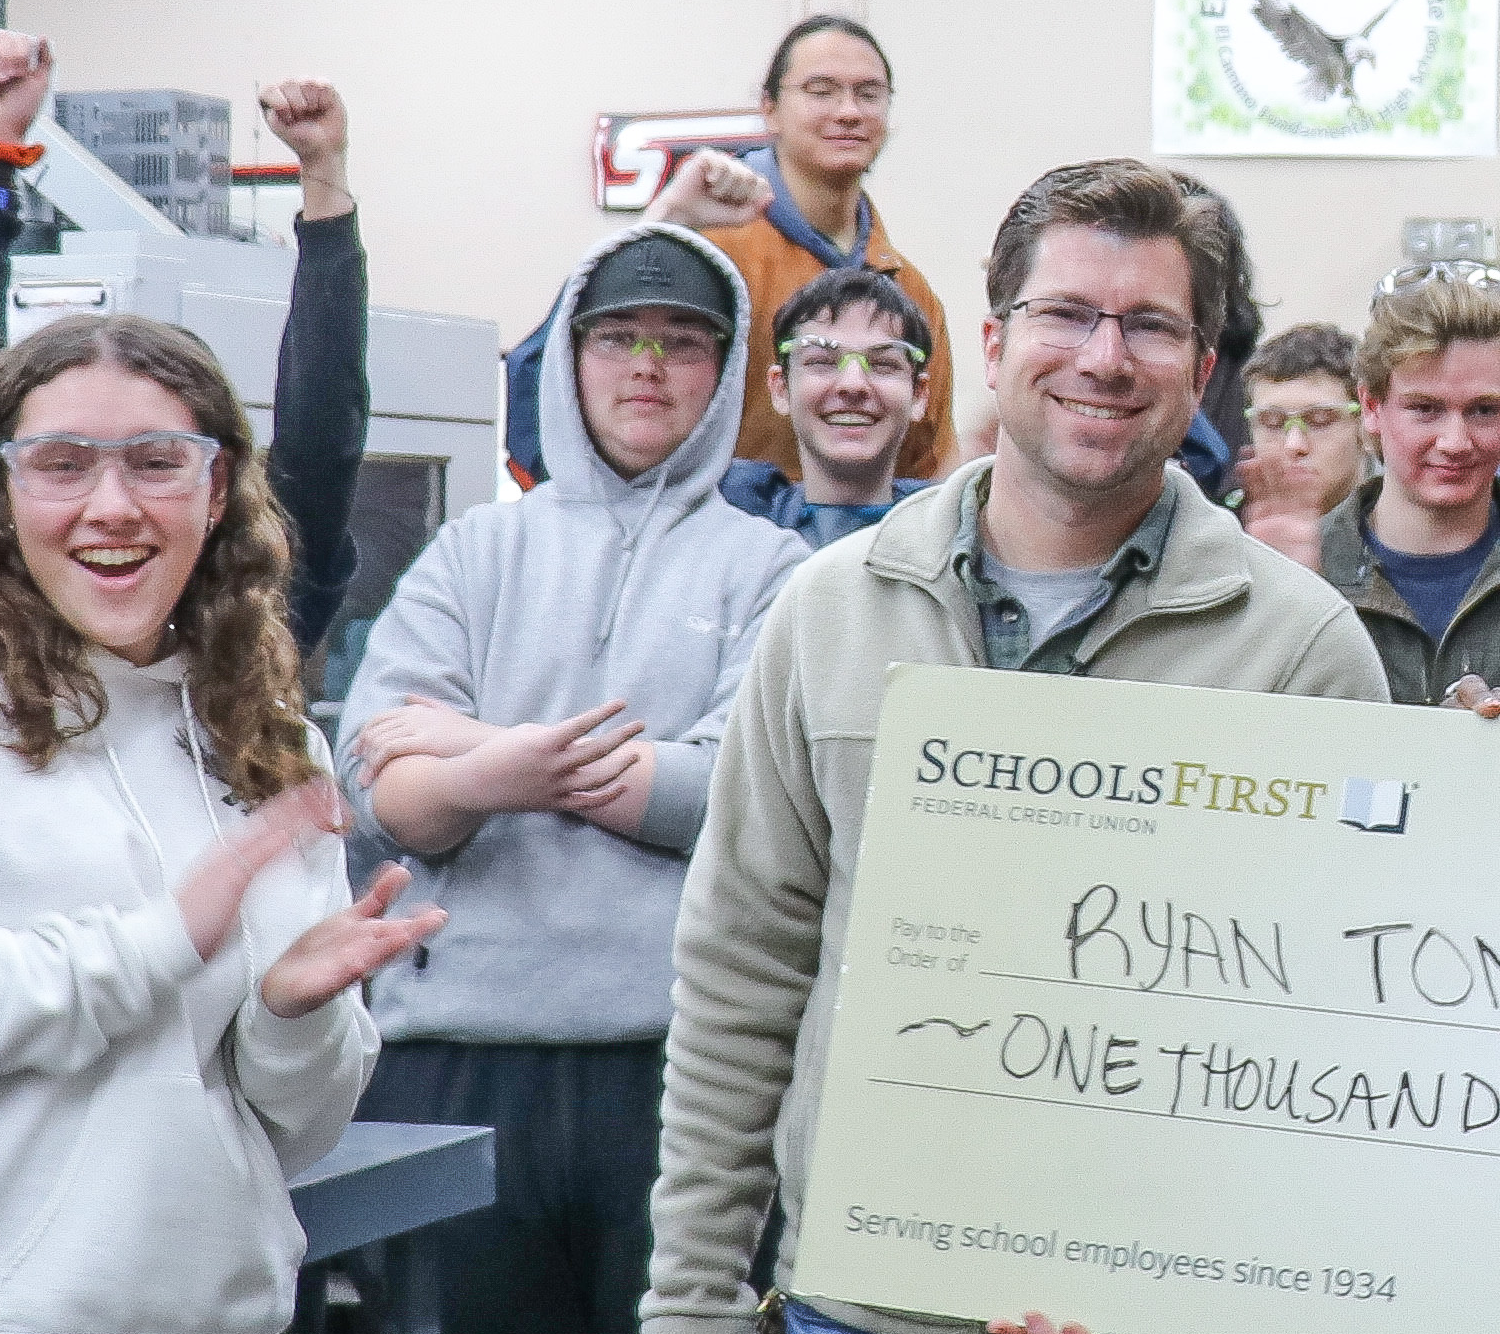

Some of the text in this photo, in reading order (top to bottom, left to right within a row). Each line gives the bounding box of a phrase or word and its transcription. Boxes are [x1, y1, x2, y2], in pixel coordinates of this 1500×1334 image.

[909, 795, 1159, 836] FEDERAL CREDIT UNION
[888, 946, 970, 972] Order of
[891, 916, 921, 942] Pay
[949, 923, 981, 944] the
[1065, 883, 1293, 995] RYAN
[1001, 1012, 1143, 1095] ONE
[843, 1203, 1399, 1304] Serving school employees since 1934
